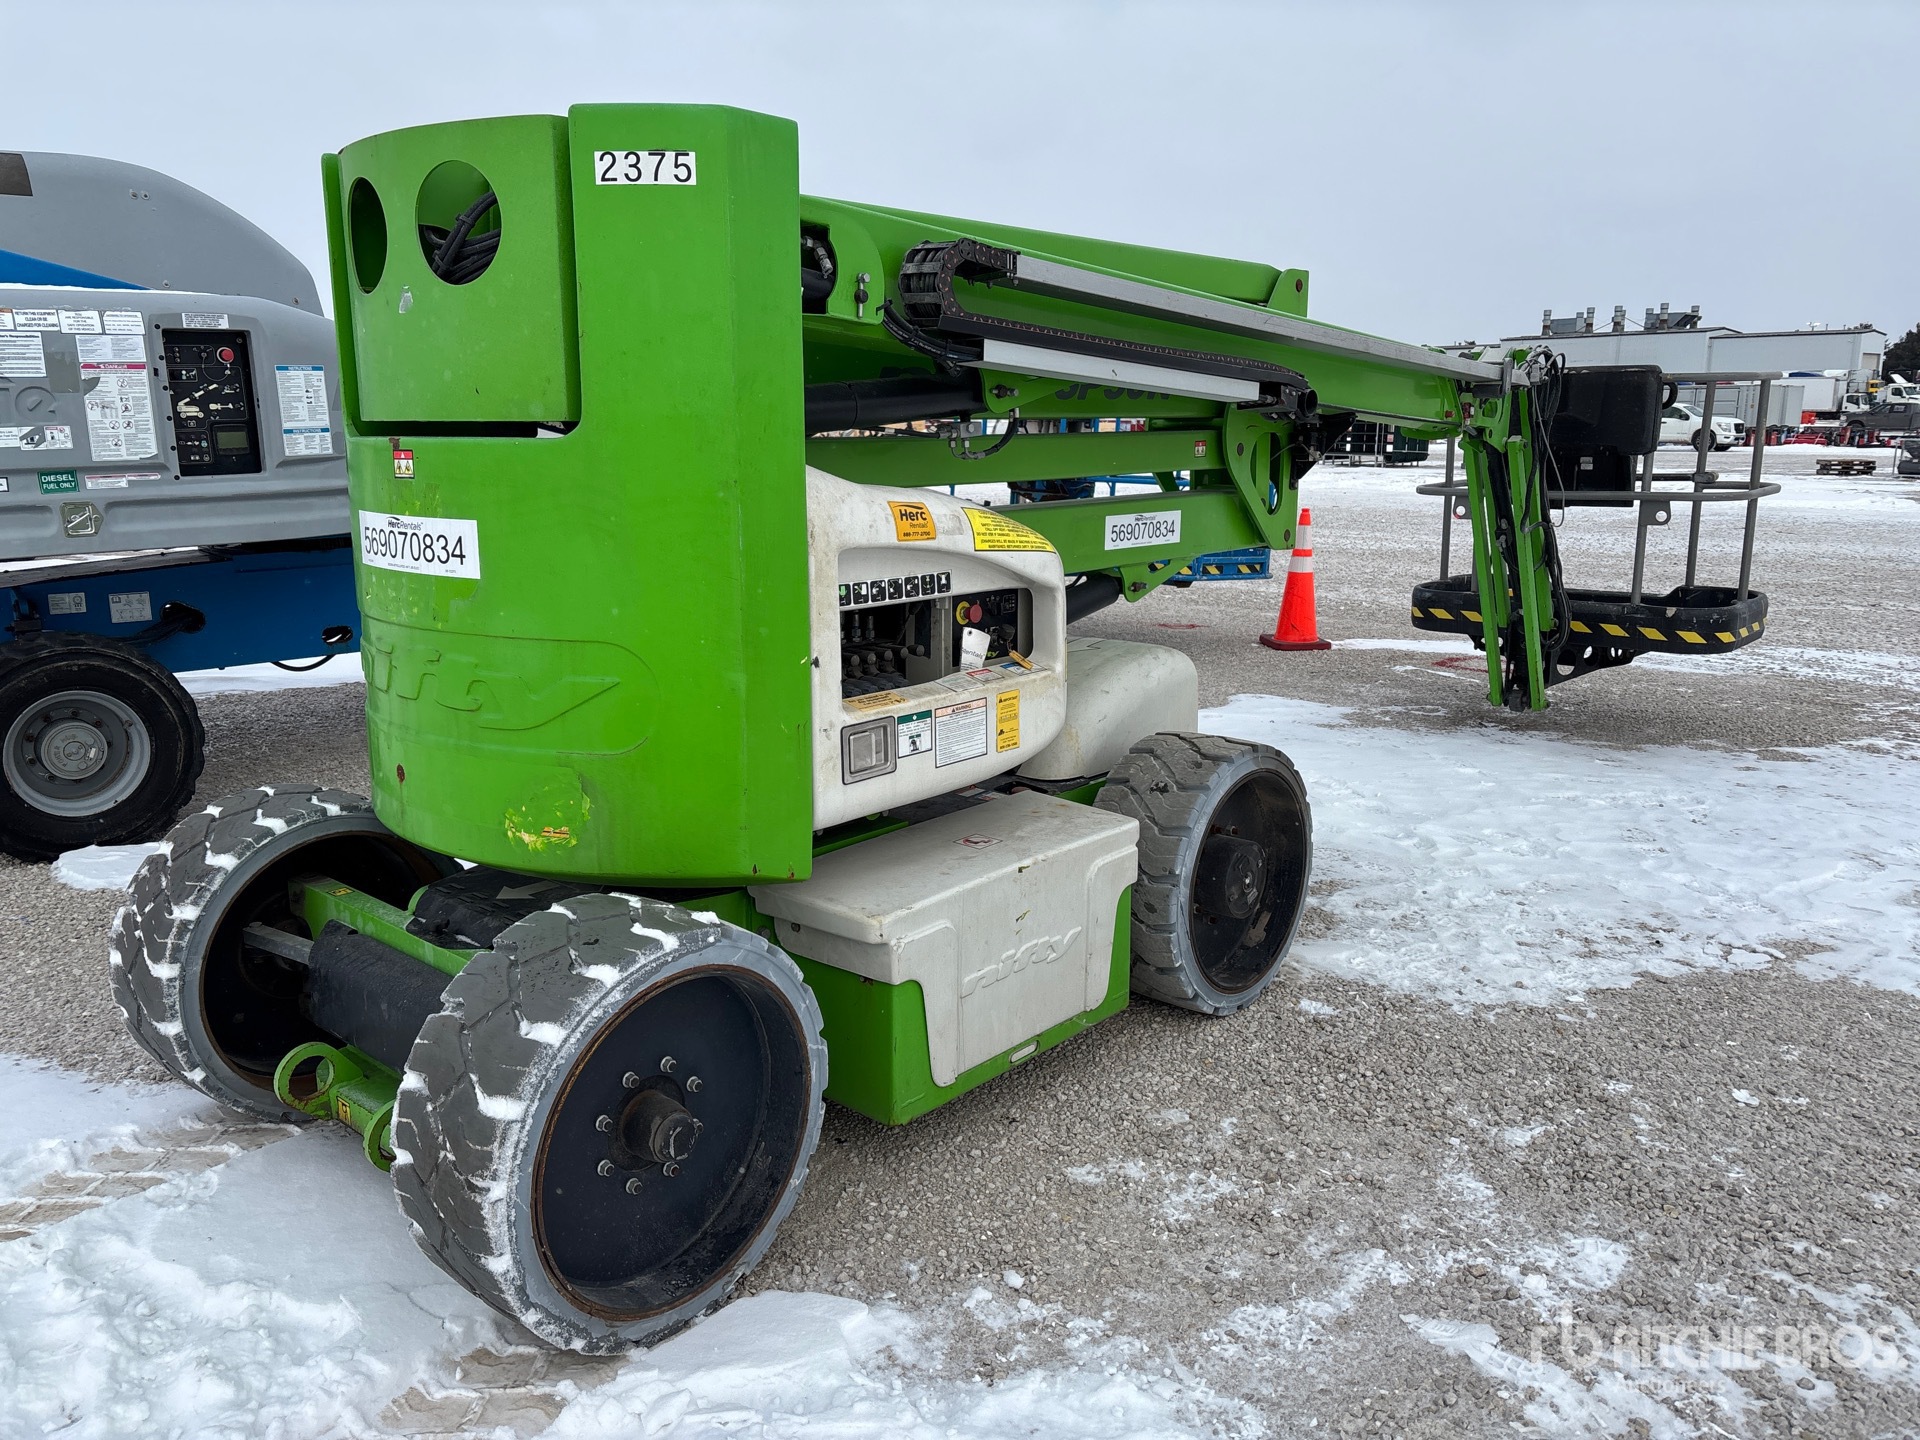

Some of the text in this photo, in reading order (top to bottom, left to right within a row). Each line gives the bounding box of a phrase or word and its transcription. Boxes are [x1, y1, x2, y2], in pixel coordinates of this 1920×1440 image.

[599, 151, 692, 182] 2375
[41, 474, 74, 482] DIESEL
[899, 509, 927, 521] Herc
[1111, 520, 1175, 543] 569070834
[364, 526, 466, 565] 569070834
[955, 704, 972, 712] WARNING
[960, 926, 1083, 999] nifty
